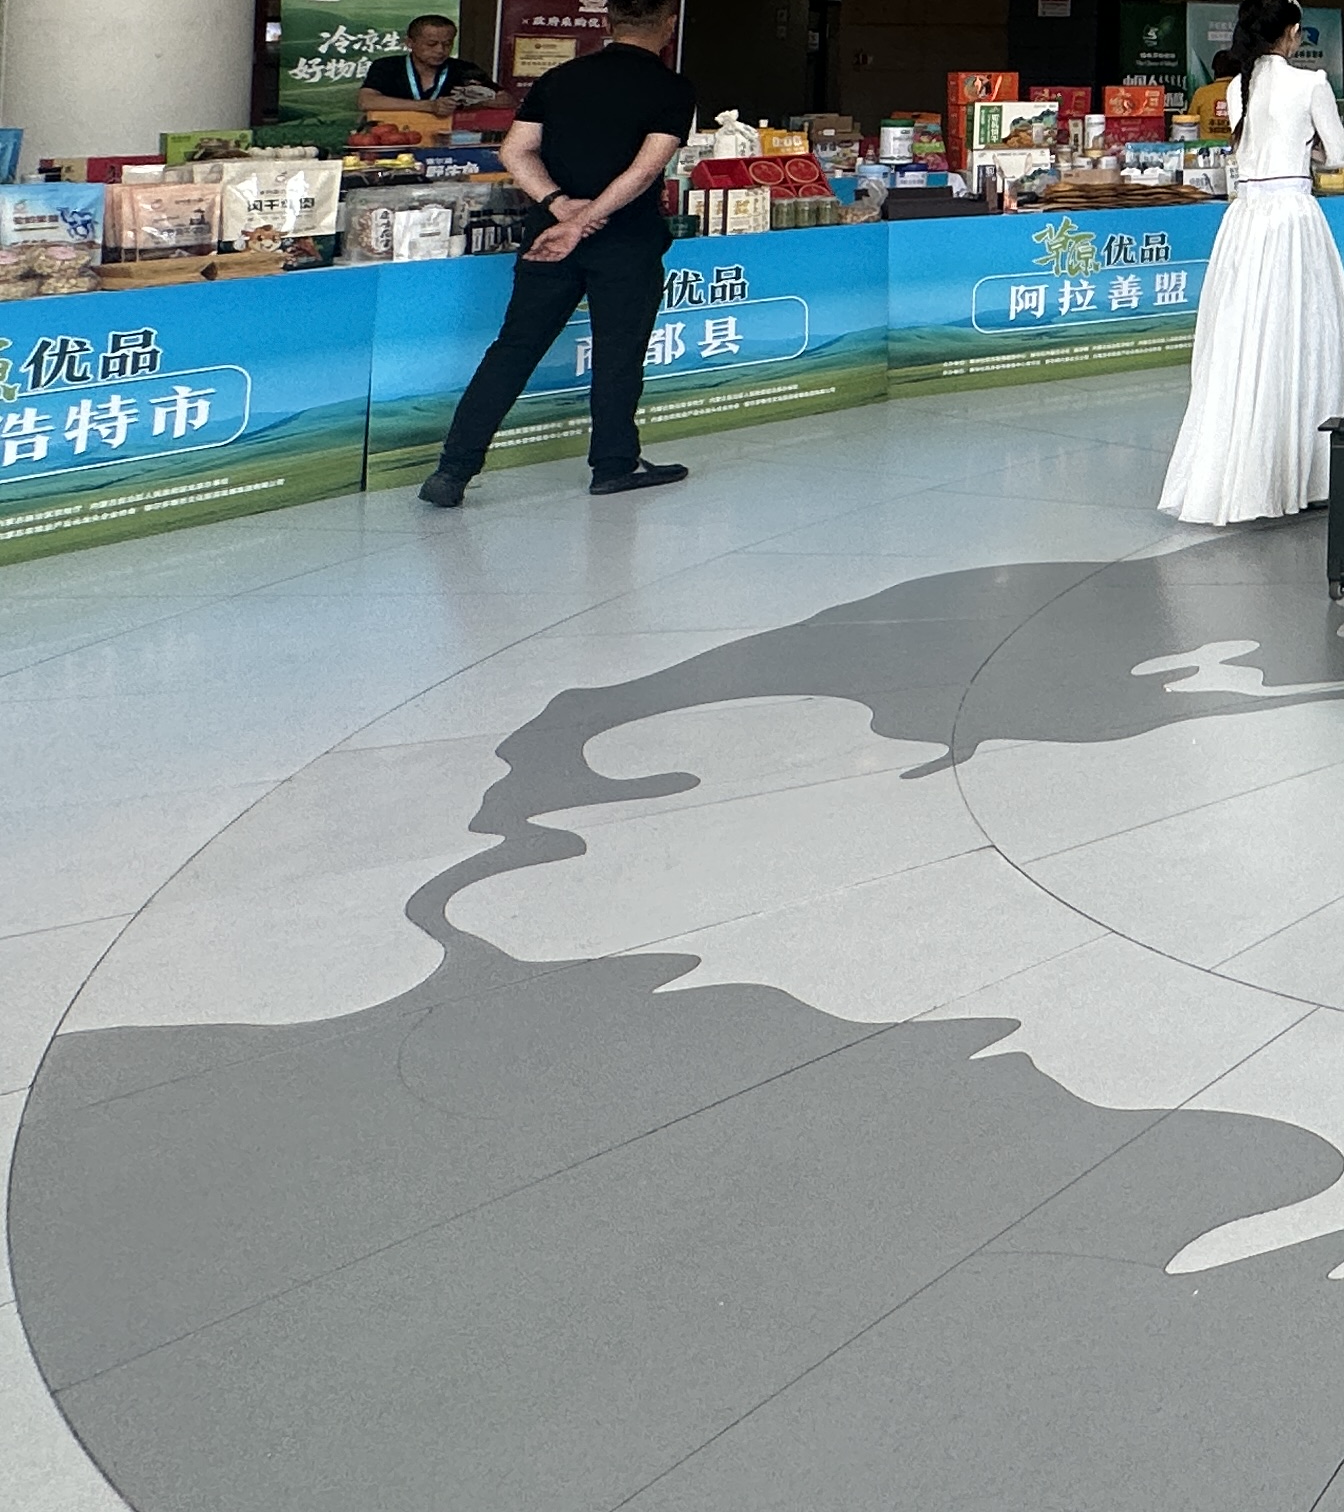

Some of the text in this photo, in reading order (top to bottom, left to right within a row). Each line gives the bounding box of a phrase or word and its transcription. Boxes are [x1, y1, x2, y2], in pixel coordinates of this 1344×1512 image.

[318, 24, 412, 54] 冷凉生
[1032, 216, 1172, 277] 草原优品
[1009, 270, 1189, 321] 阿拉善盟
